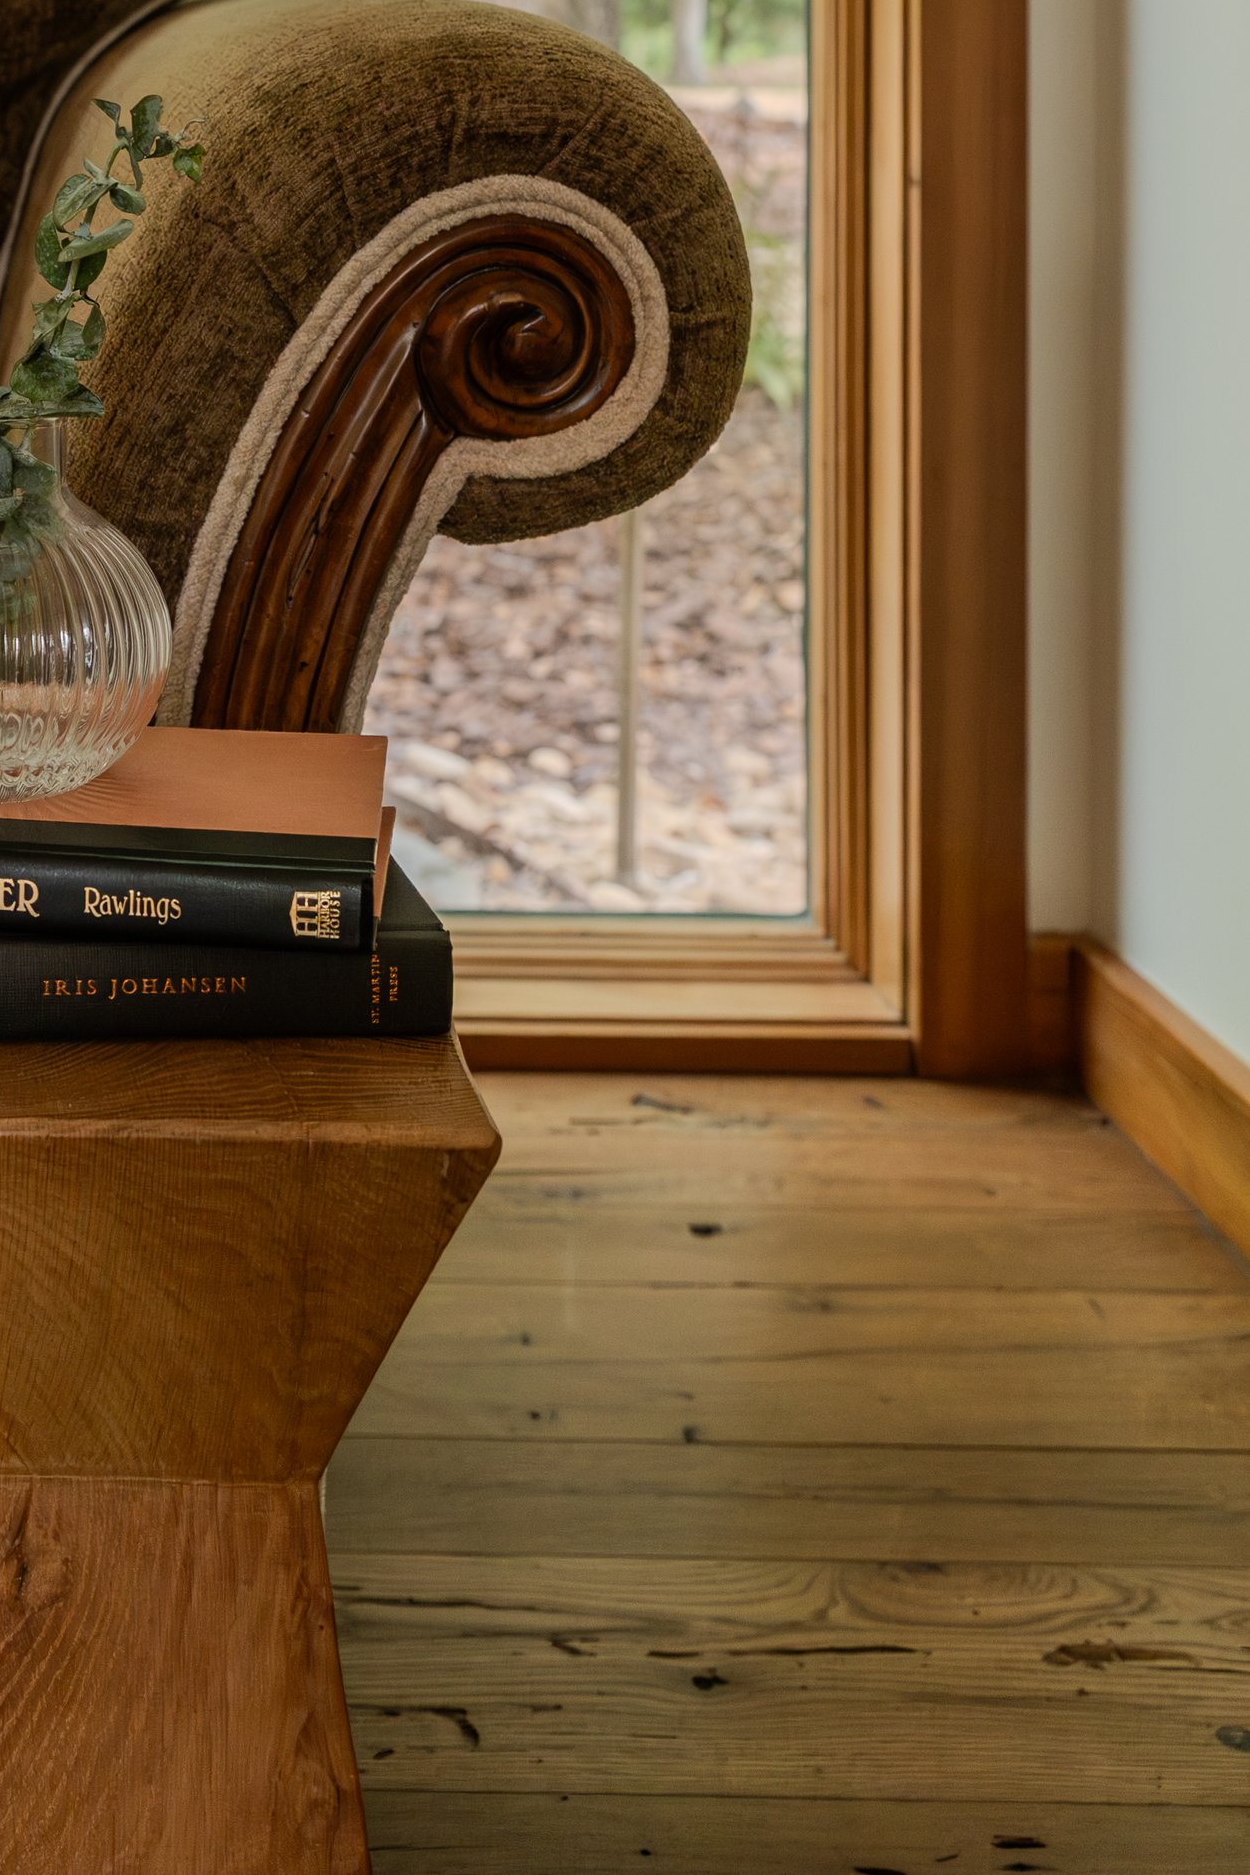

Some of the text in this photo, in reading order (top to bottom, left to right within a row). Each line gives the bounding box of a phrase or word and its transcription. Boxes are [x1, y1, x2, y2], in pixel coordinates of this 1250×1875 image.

[83, 886, 182, 925] Rawlings
[319, 891, 330, 938] HARBOR
[330, 891, 341, 939] HOUSE
[43, 975, 248, 1000] IRIS JOHANSEN
[371, 953, 380, 1024] ST. MARTIN
[389, 966, 399, 1002] PRESS
